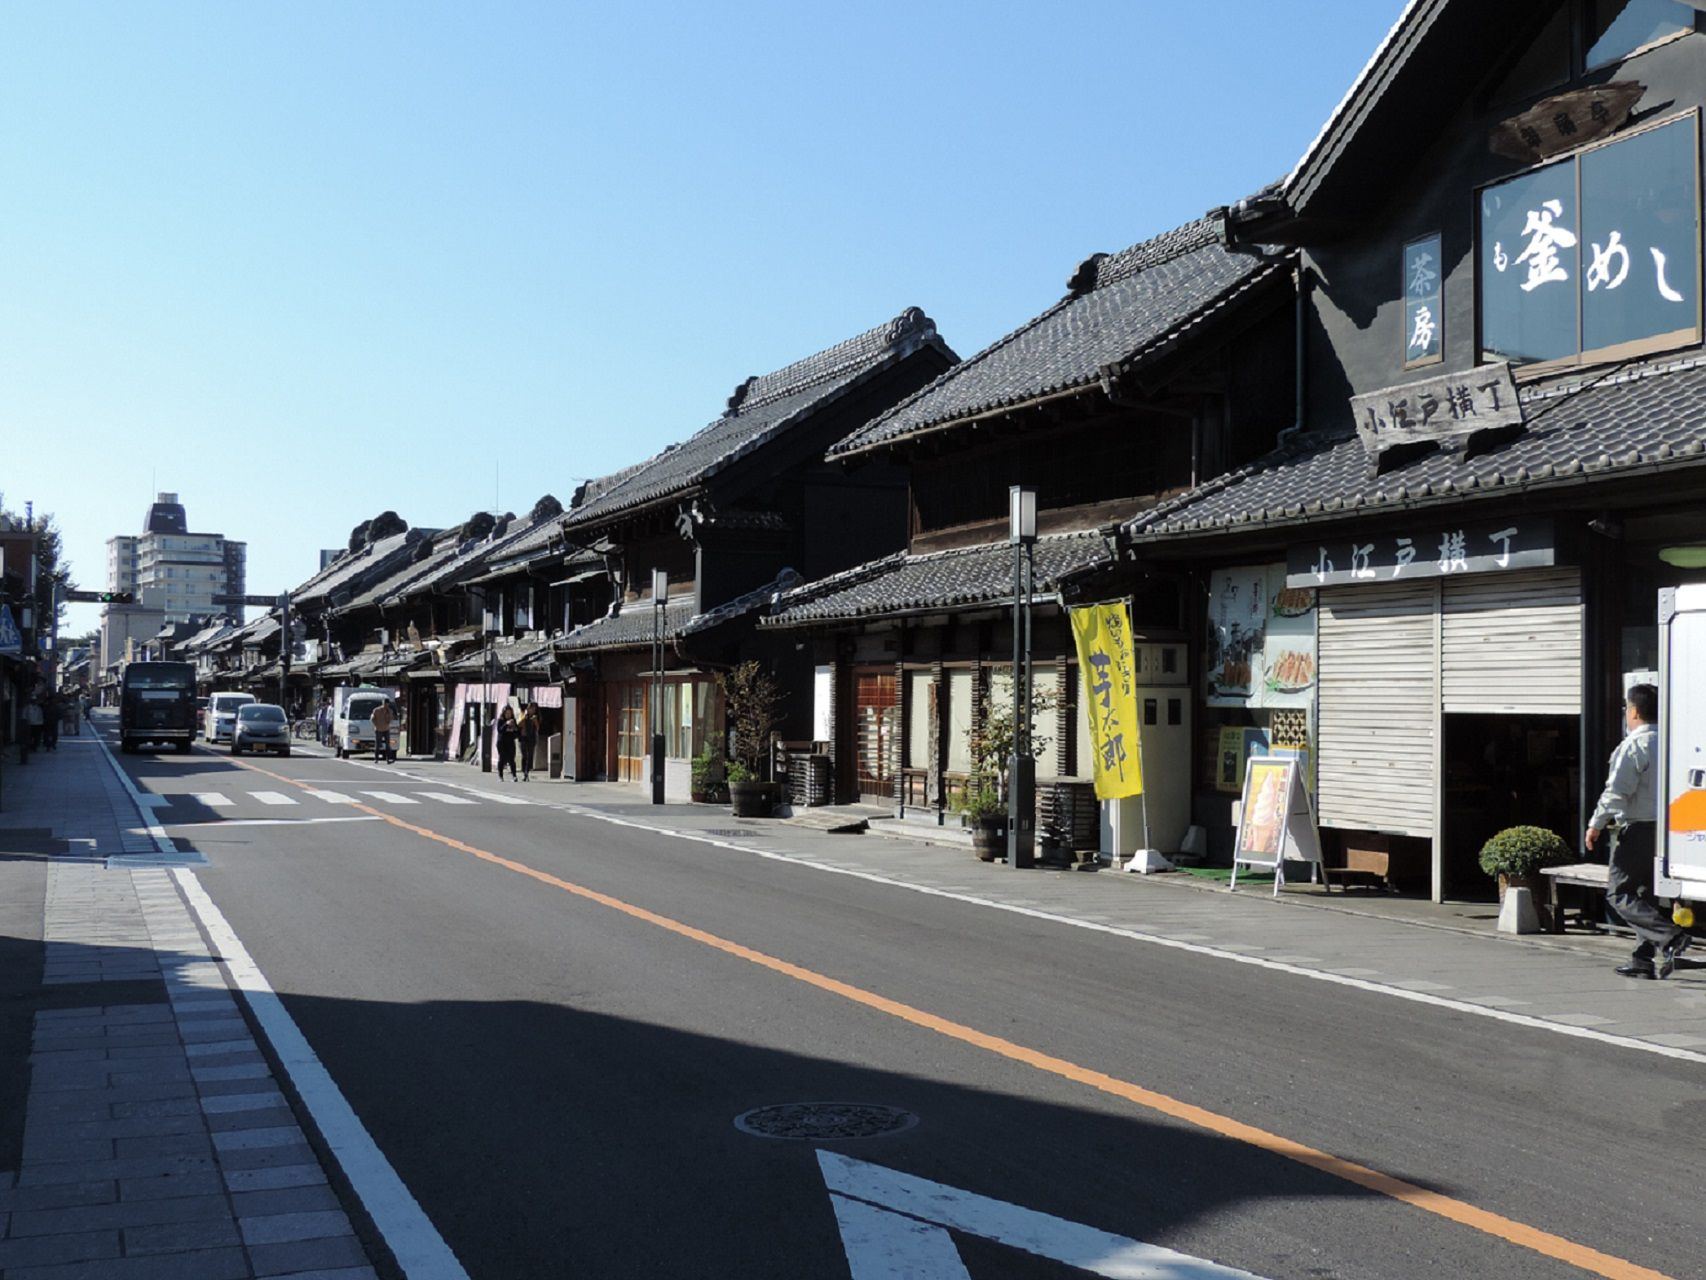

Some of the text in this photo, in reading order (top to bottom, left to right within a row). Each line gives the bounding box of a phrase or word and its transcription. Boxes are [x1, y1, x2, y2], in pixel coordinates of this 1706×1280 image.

[1511, 199, 1684, 301] 釜めし
[1411, 253, 1436, 350] 茶房
[1367, 380, 1502, 434] 小江戸横丁
[1311, 528, 1517, 583] 小江戸横丁
[1088, 646, 1126, 782] 芋太郎
